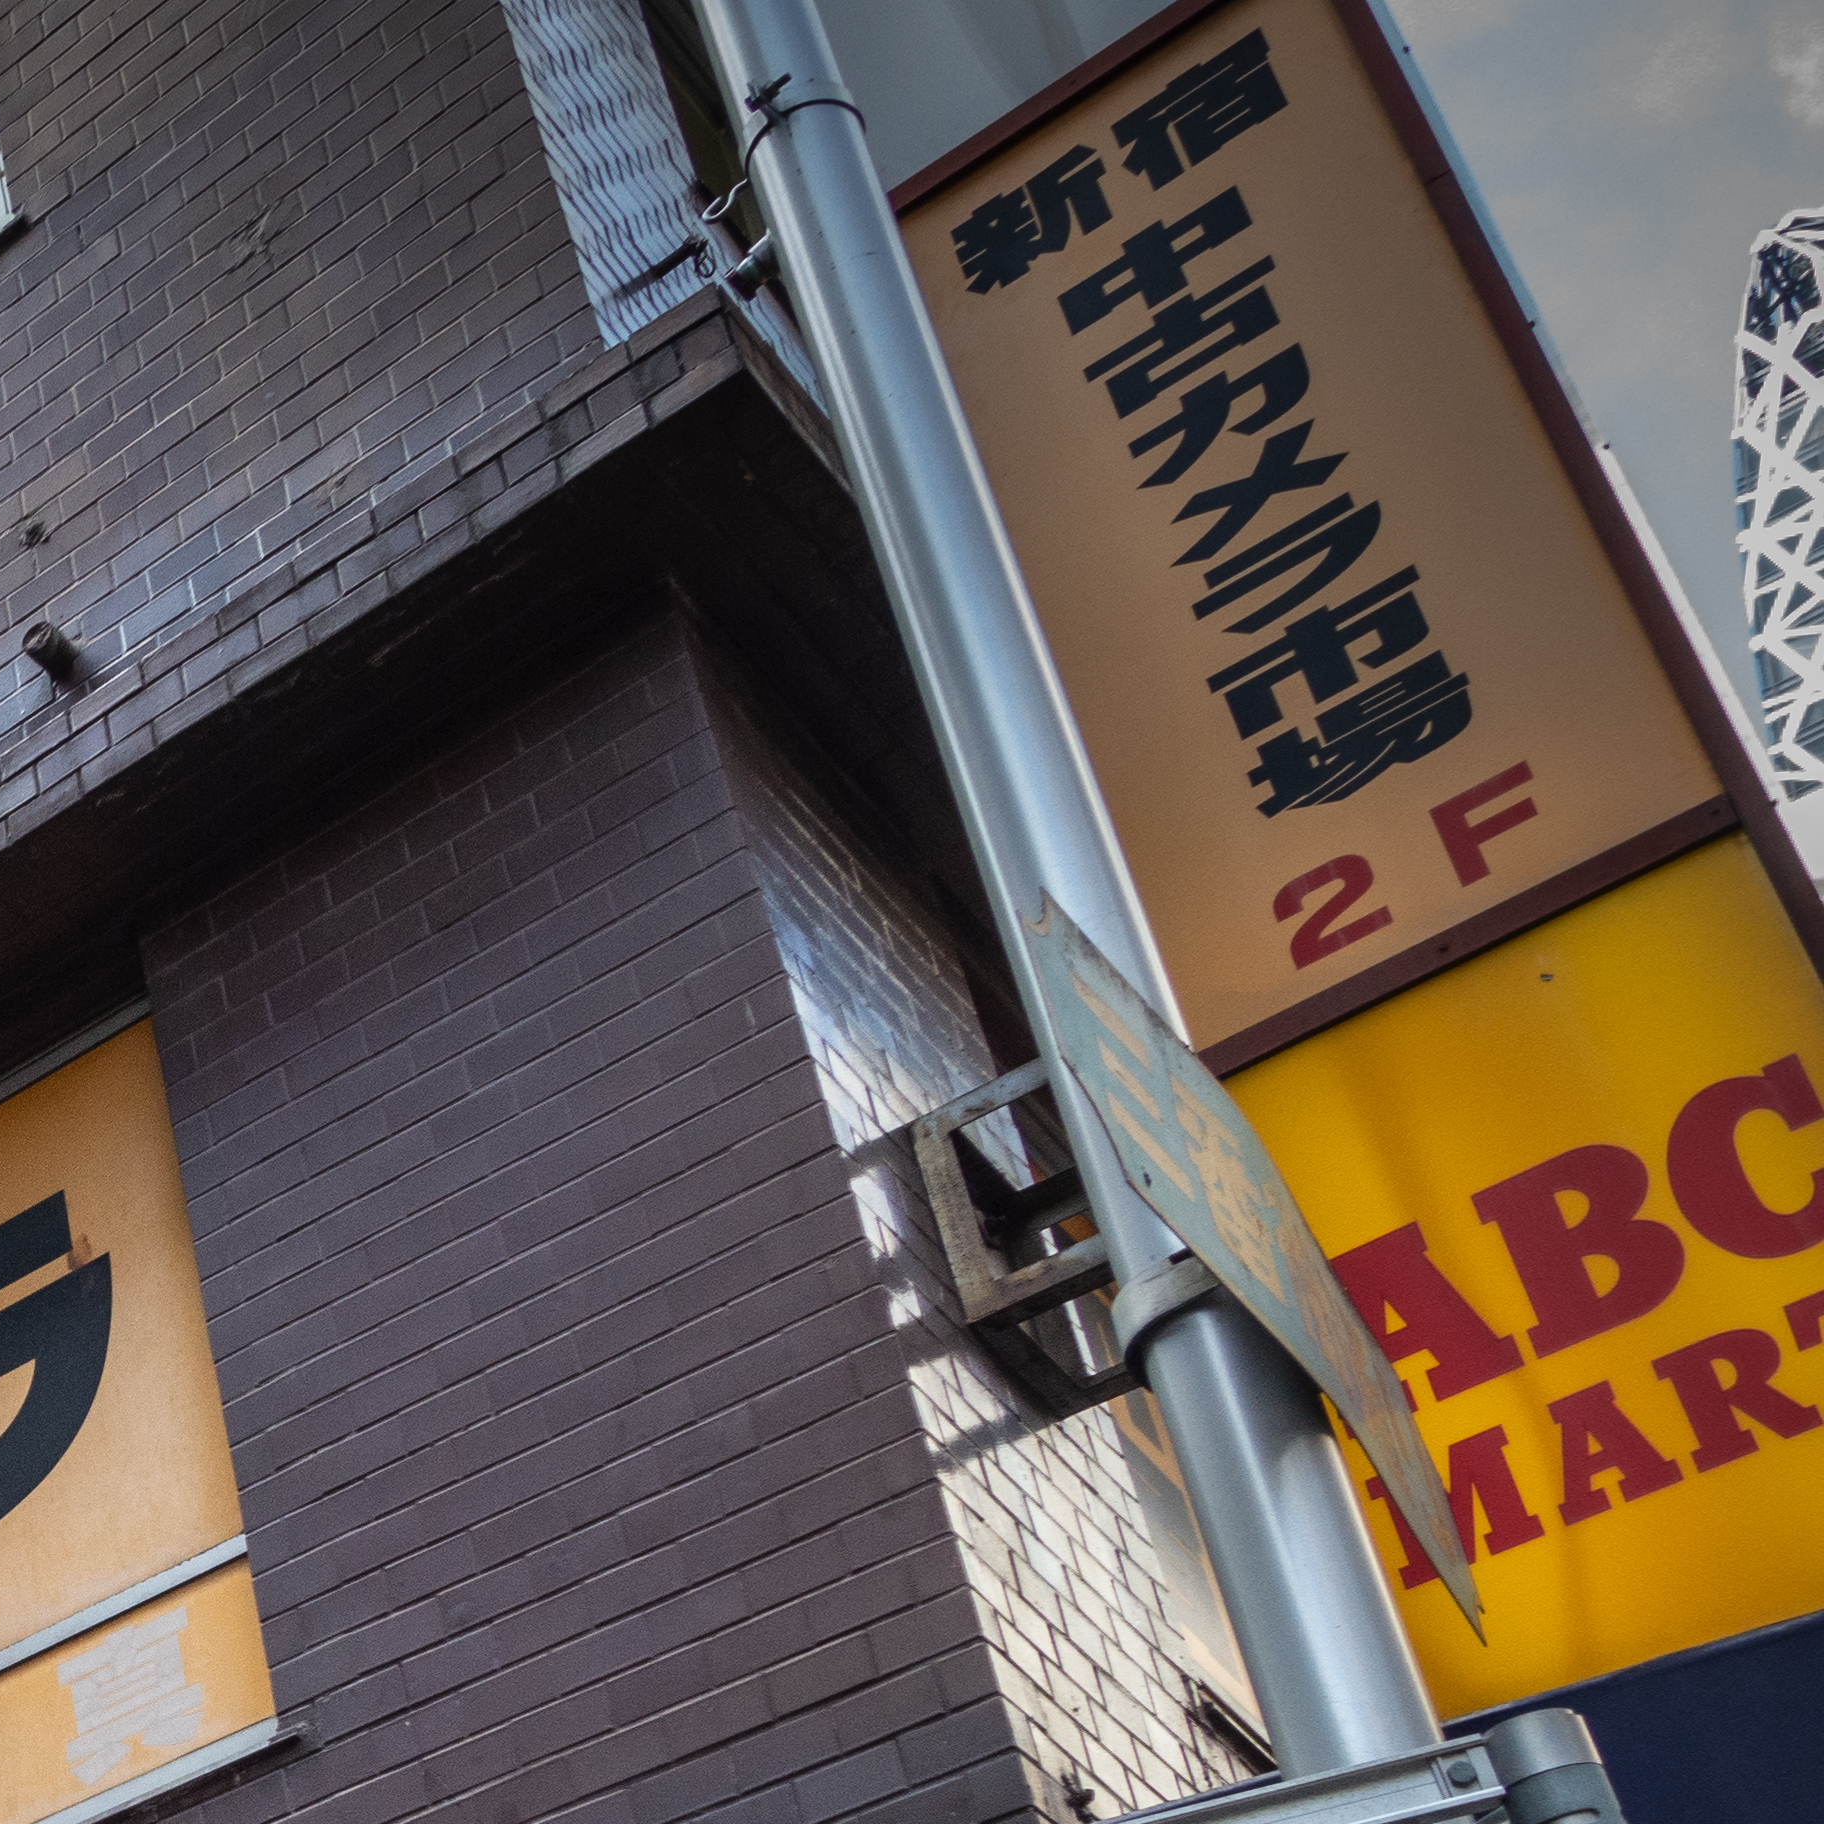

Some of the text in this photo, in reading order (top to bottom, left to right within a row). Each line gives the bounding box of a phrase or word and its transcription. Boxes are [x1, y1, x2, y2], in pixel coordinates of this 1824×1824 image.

[951, 28, 1288, 295] 新宿
[1057, 185, 1473, 819] 中古カメラ市場
[1272, 760, 1538, 971] 2F
[1331, 1054, 1824, 1438] ABC
[1370, 1294, 1824, 1590] MAR
